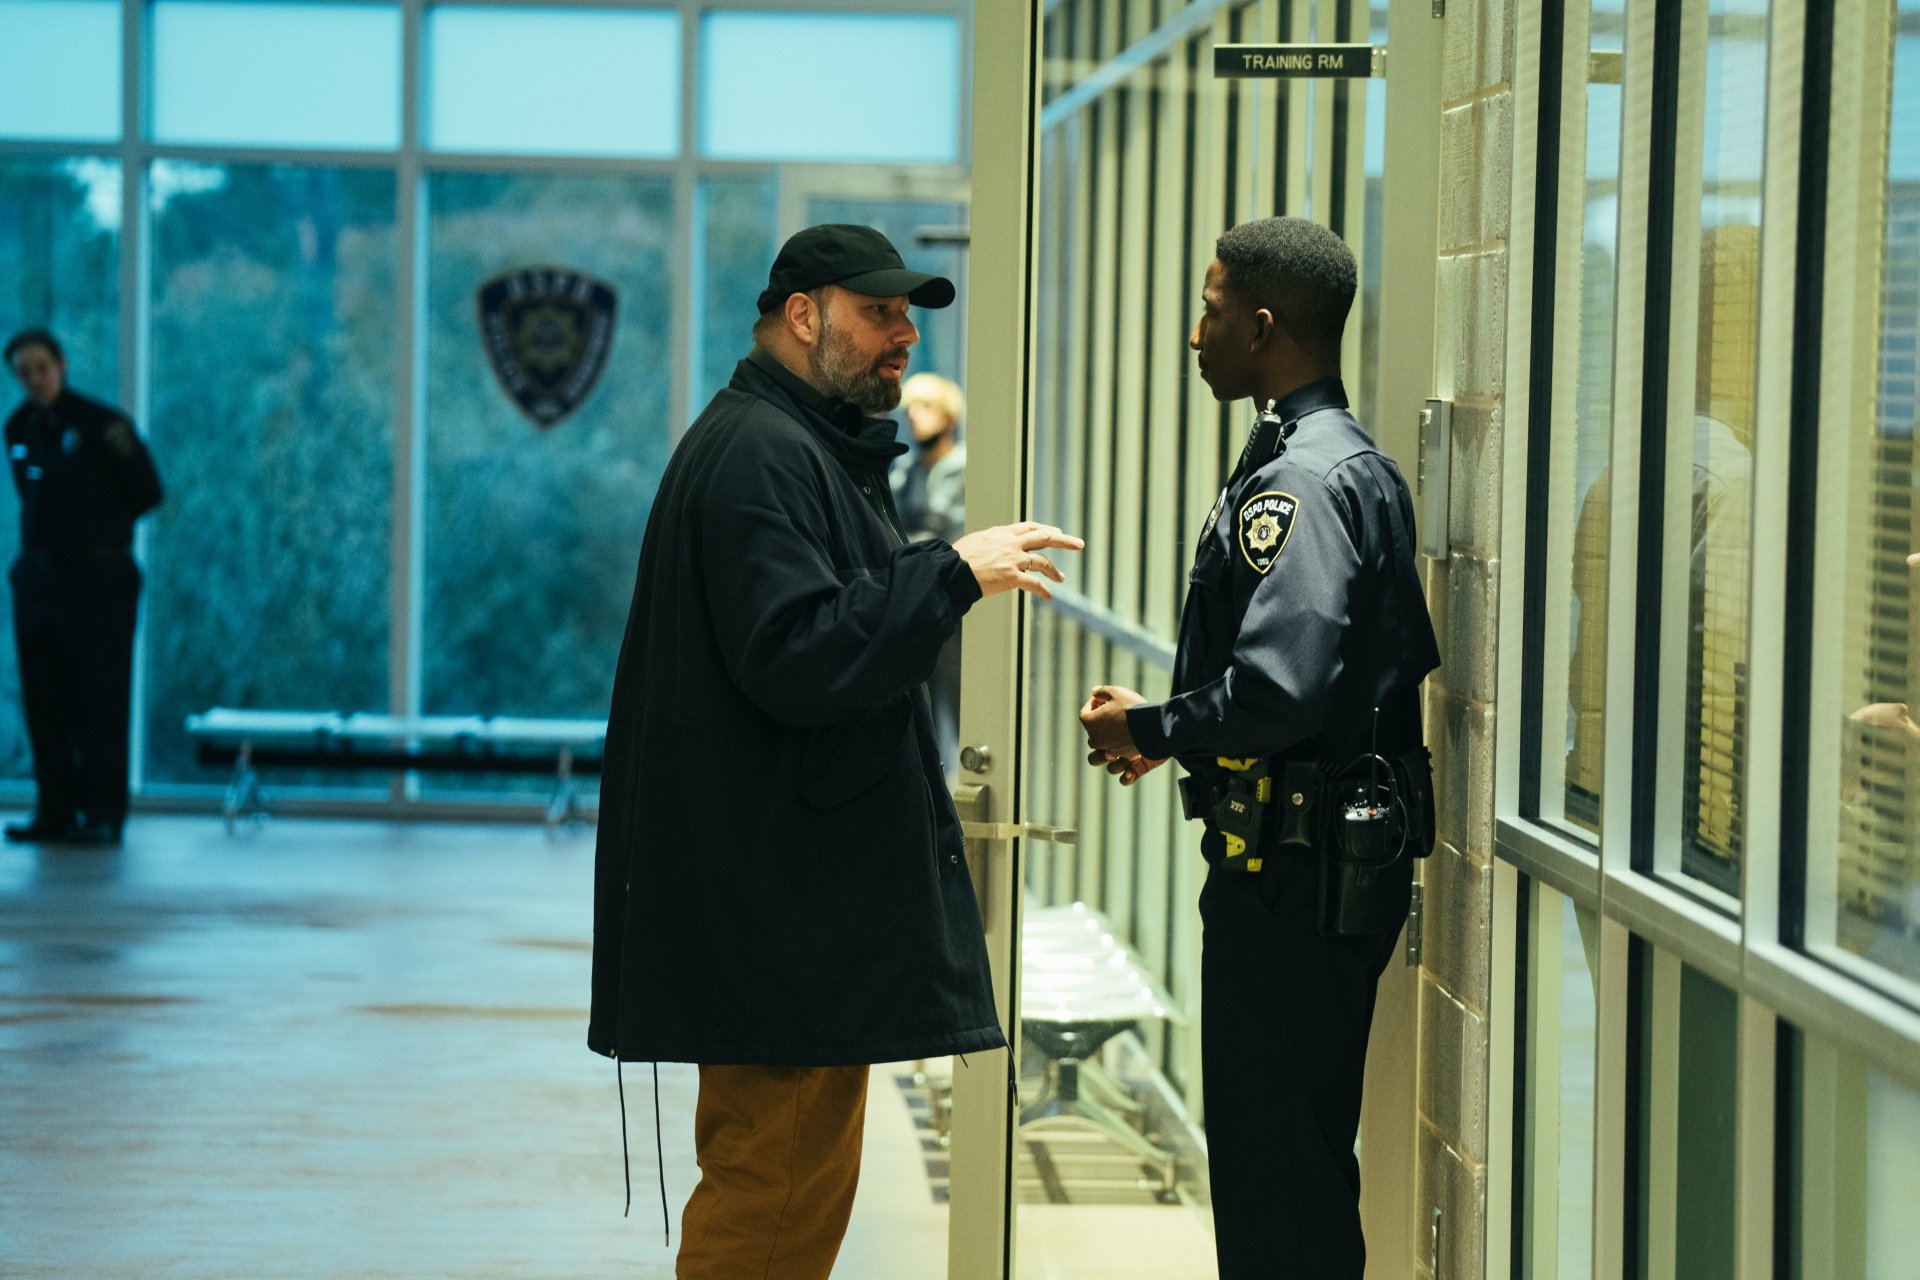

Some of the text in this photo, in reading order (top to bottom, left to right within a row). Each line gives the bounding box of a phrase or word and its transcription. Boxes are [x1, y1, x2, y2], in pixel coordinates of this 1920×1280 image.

[1242, 54, 1344, 70] TRAINING RM
[1263, 499, 1294, 516] POLICE
